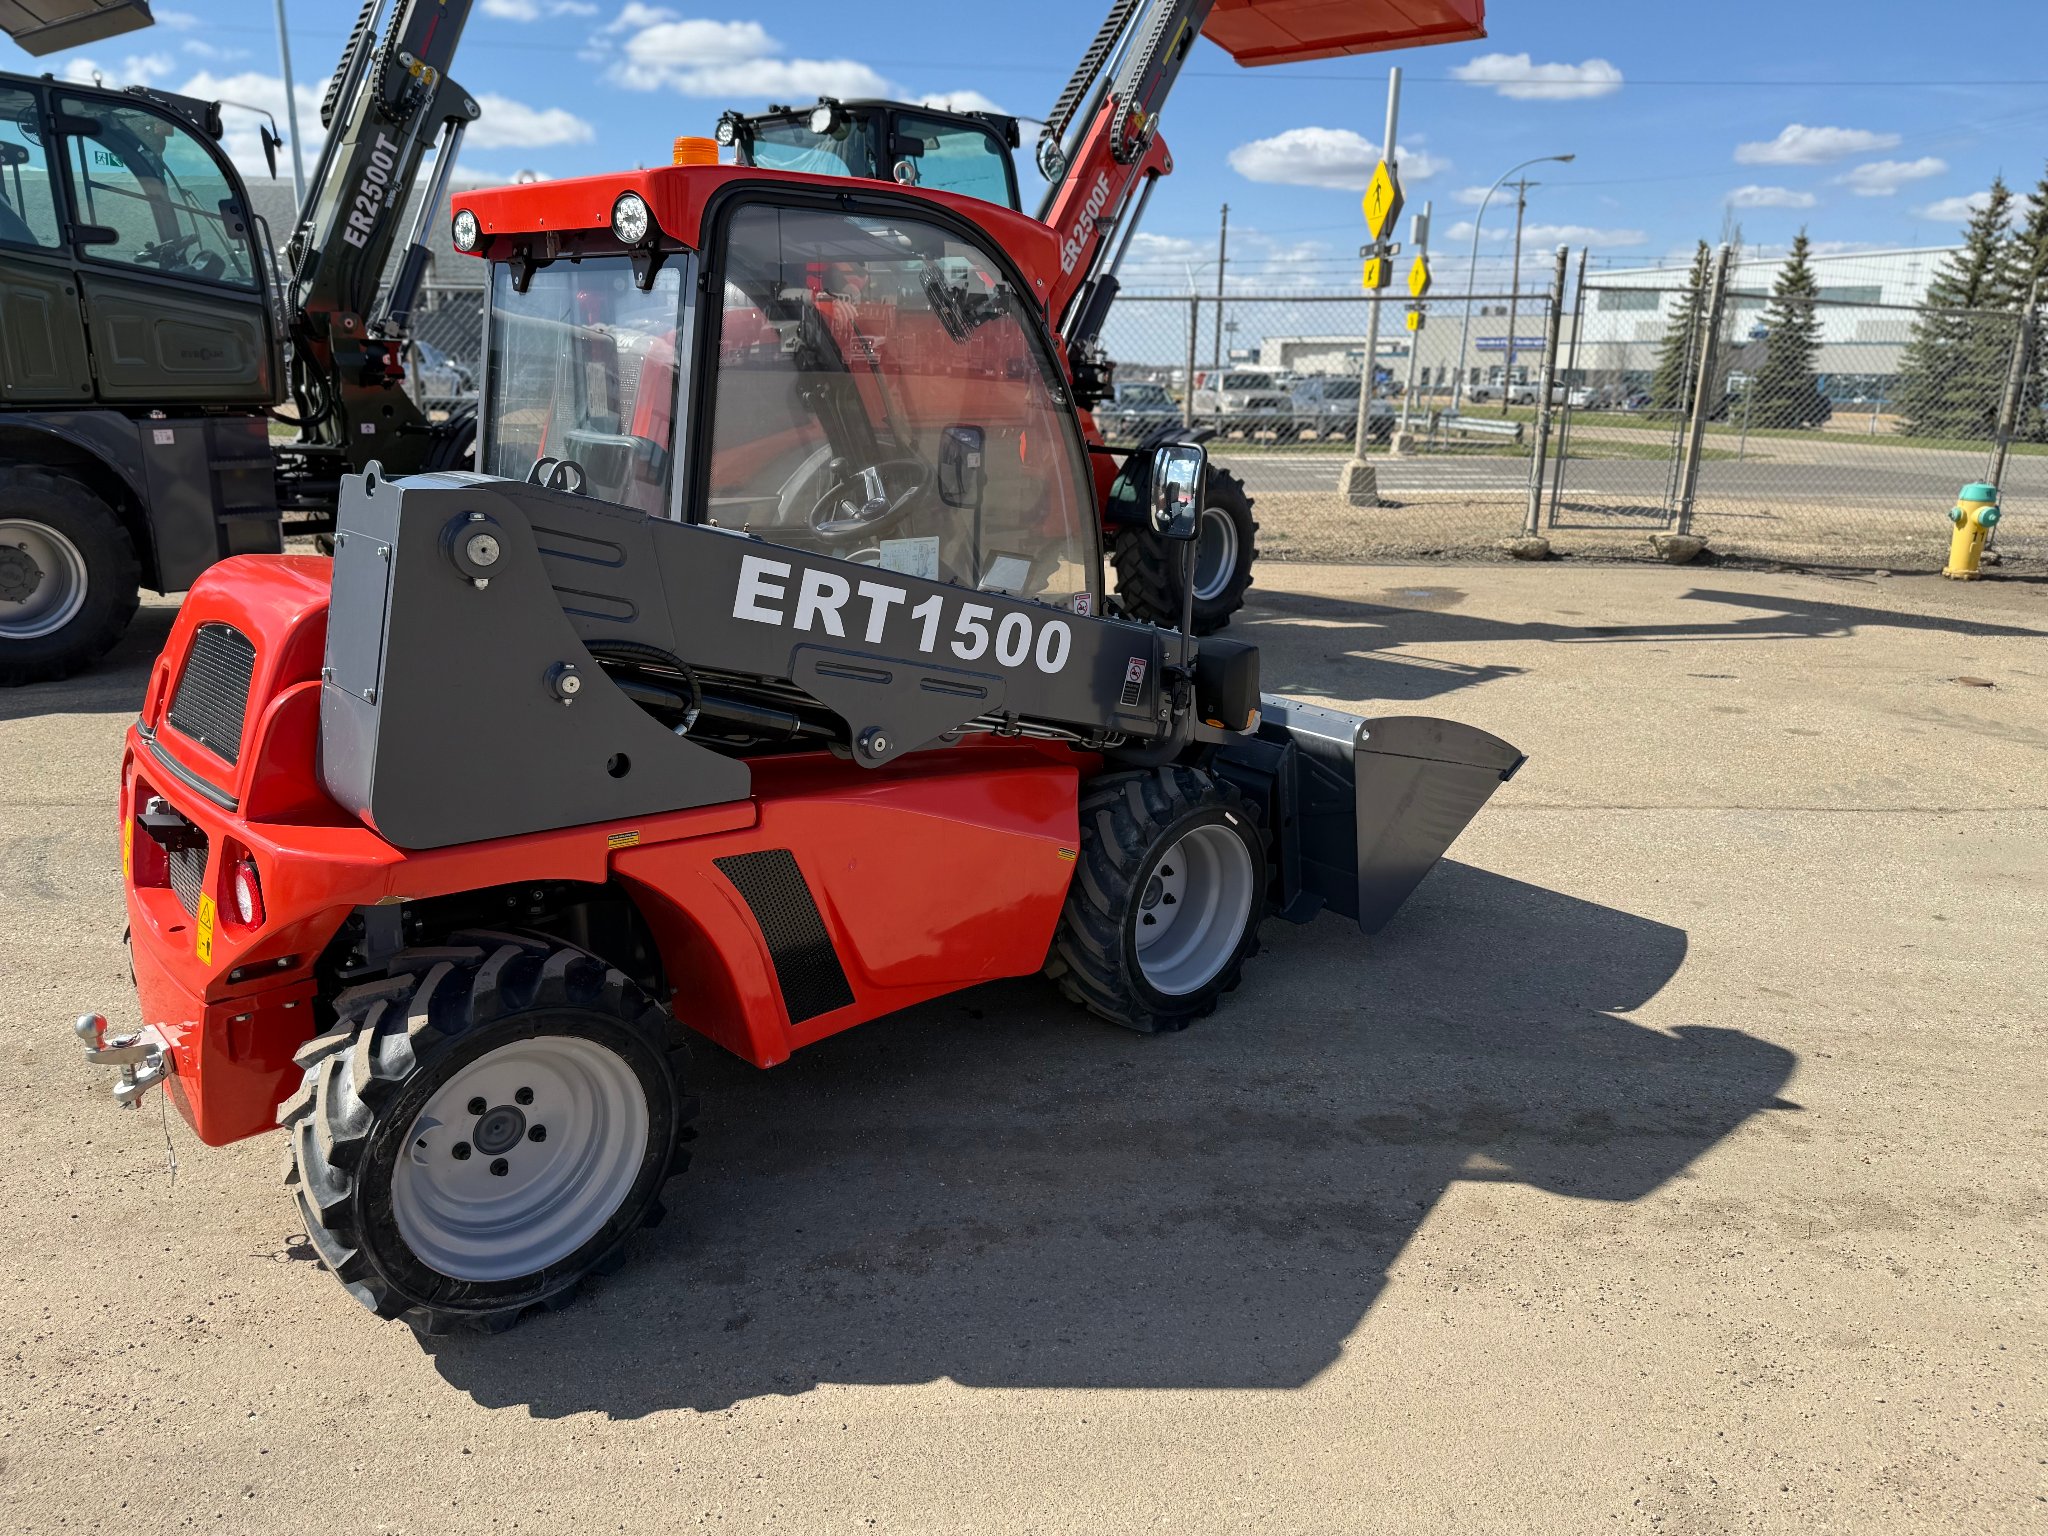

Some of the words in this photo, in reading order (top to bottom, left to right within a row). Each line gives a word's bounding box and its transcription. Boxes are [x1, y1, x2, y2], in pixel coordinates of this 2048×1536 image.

[343, 131, 398, 249] ER2500T
[1062, 171, 1110, 275] ER2500F
[733, 555, 1071, 673] ERT1500
